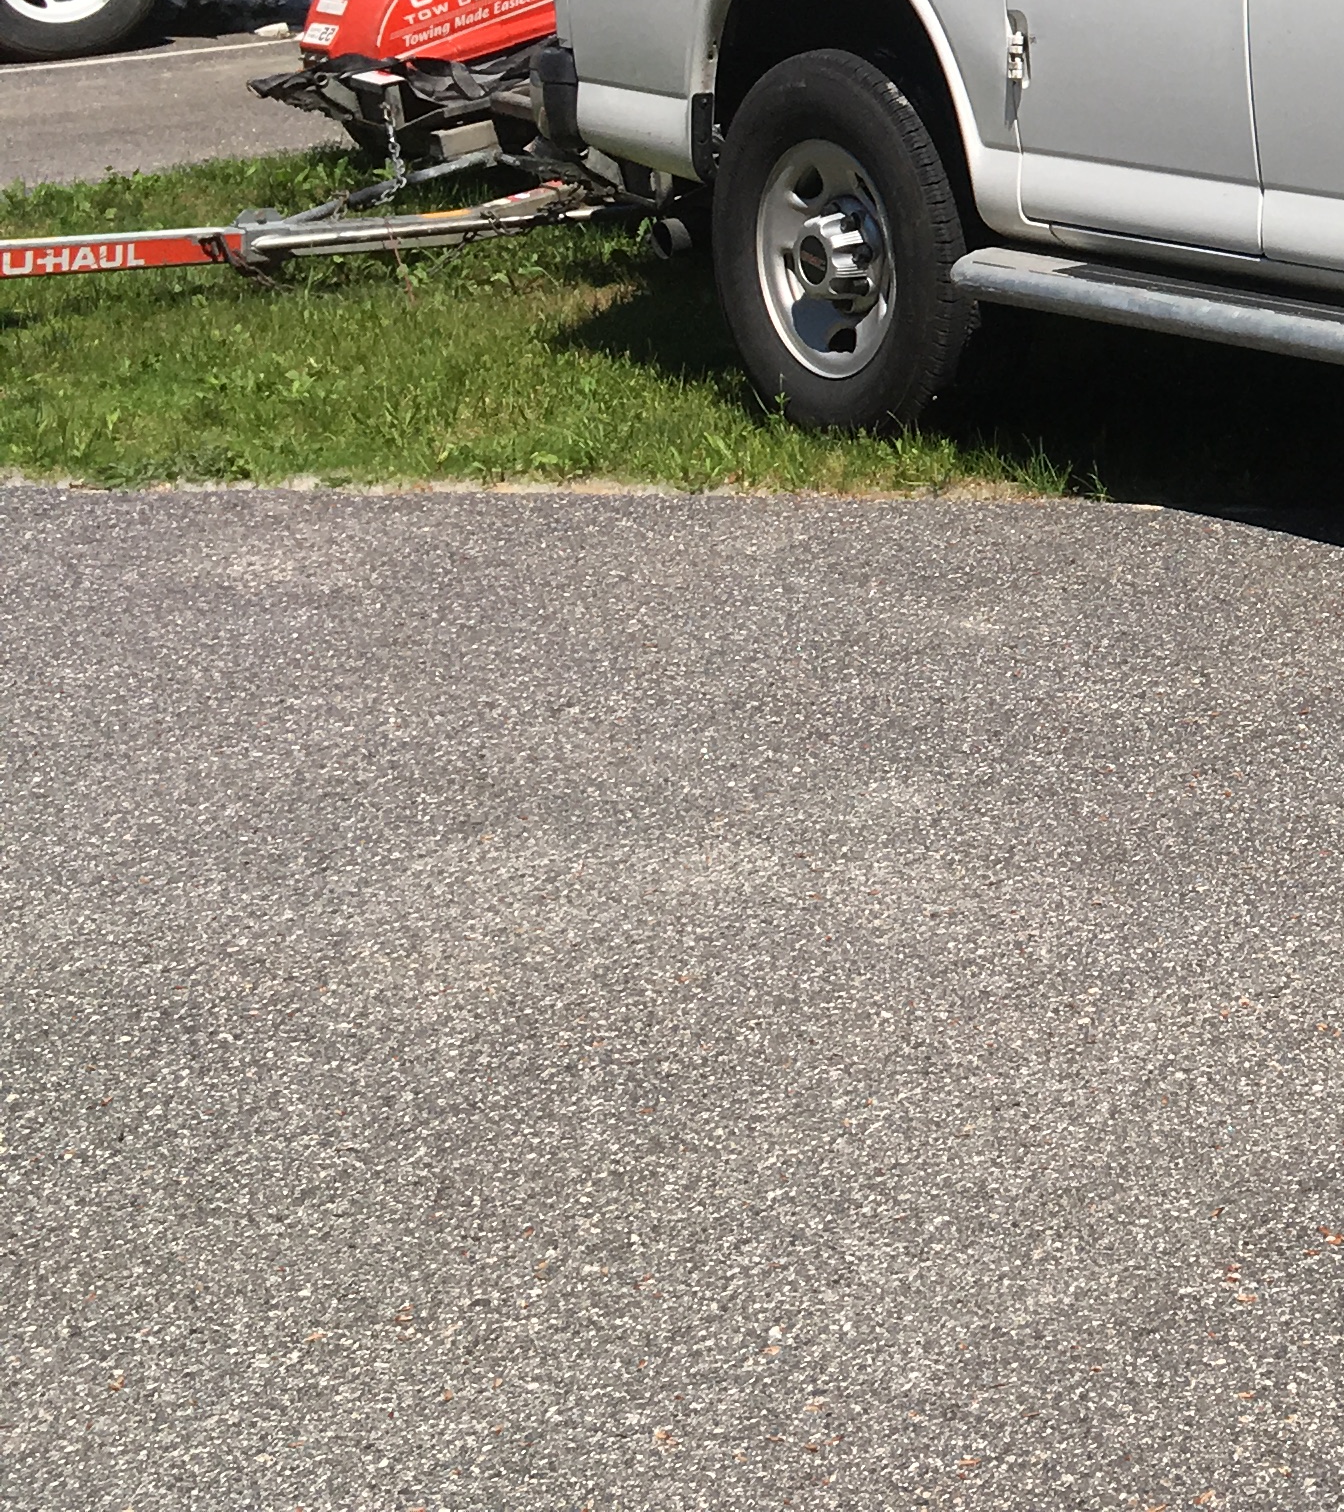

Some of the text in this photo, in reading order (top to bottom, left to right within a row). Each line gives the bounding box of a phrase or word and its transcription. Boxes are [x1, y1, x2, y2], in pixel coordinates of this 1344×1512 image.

[402, 22, 450, 47] Towing
[454, 7, 490, 29] Made
[403, 1, 449, 24] TOW
[2, 243, 145, 275] U-HAUL
